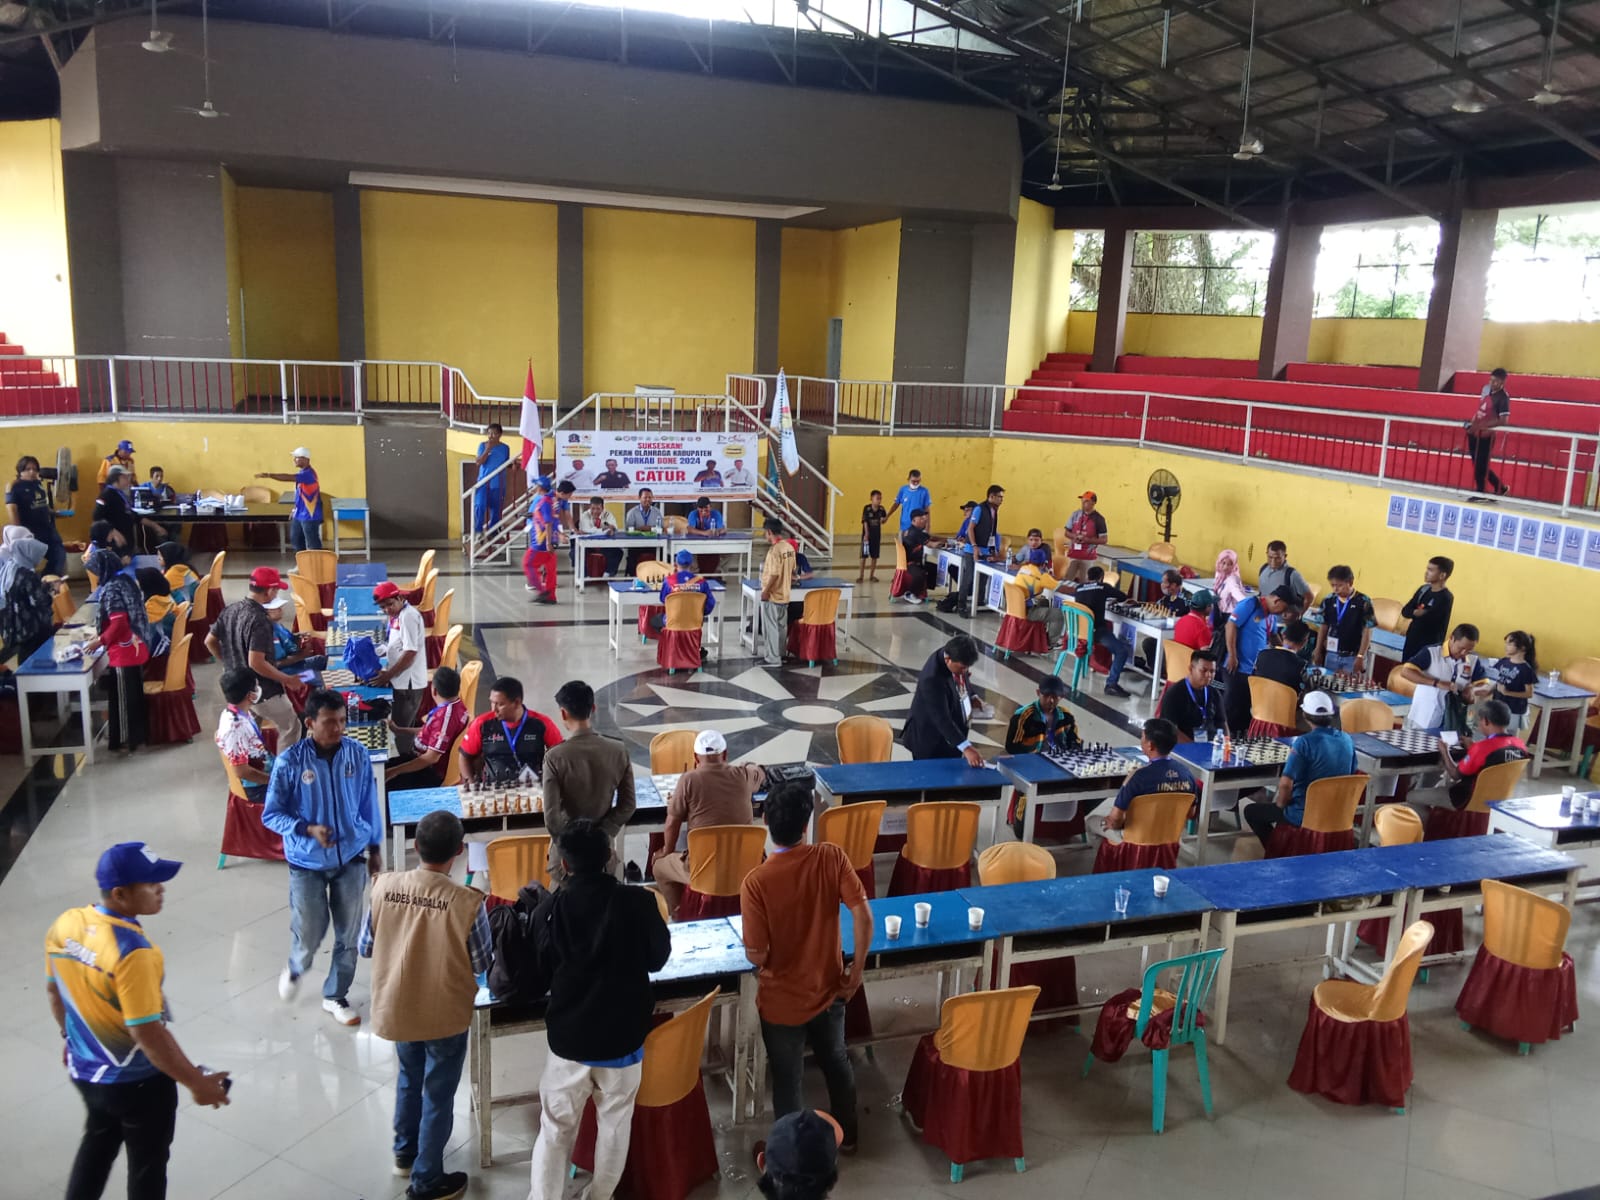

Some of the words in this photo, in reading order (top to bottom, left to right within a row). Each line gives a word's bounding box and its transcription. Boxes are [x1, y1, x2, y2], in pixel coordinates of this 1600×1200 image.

[635, 470, 686, 482] CATUR
[384, 892, 411, 904] KADES
[411, 896, 449, 911] ANDALAN
